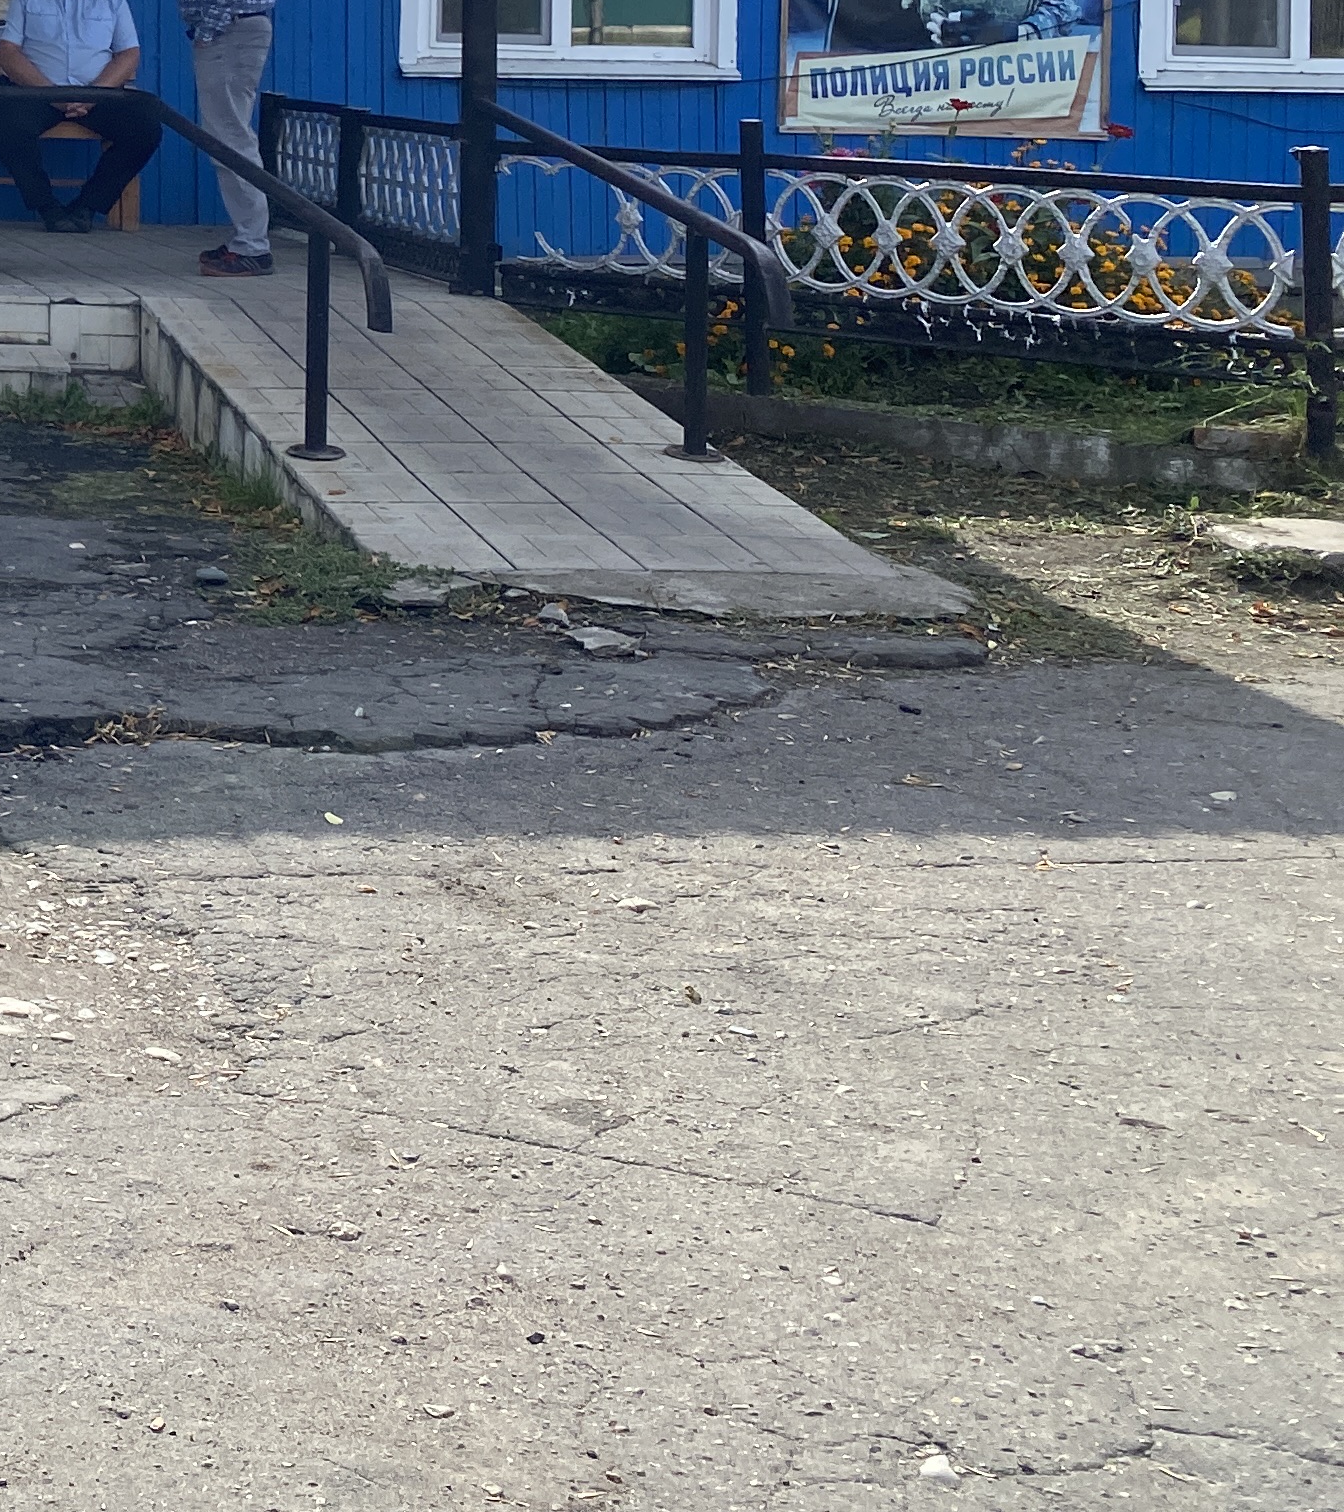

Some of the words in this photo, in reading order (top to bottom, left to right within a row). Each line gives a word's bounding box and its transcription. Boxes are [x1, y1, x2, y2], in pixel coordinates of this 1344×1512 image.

[810, 59, 949, 99] ПОЛИЦИЯ
[959, 49, 1076, 89] РОССИИ
[874, 94, 932, 122] Всегда
